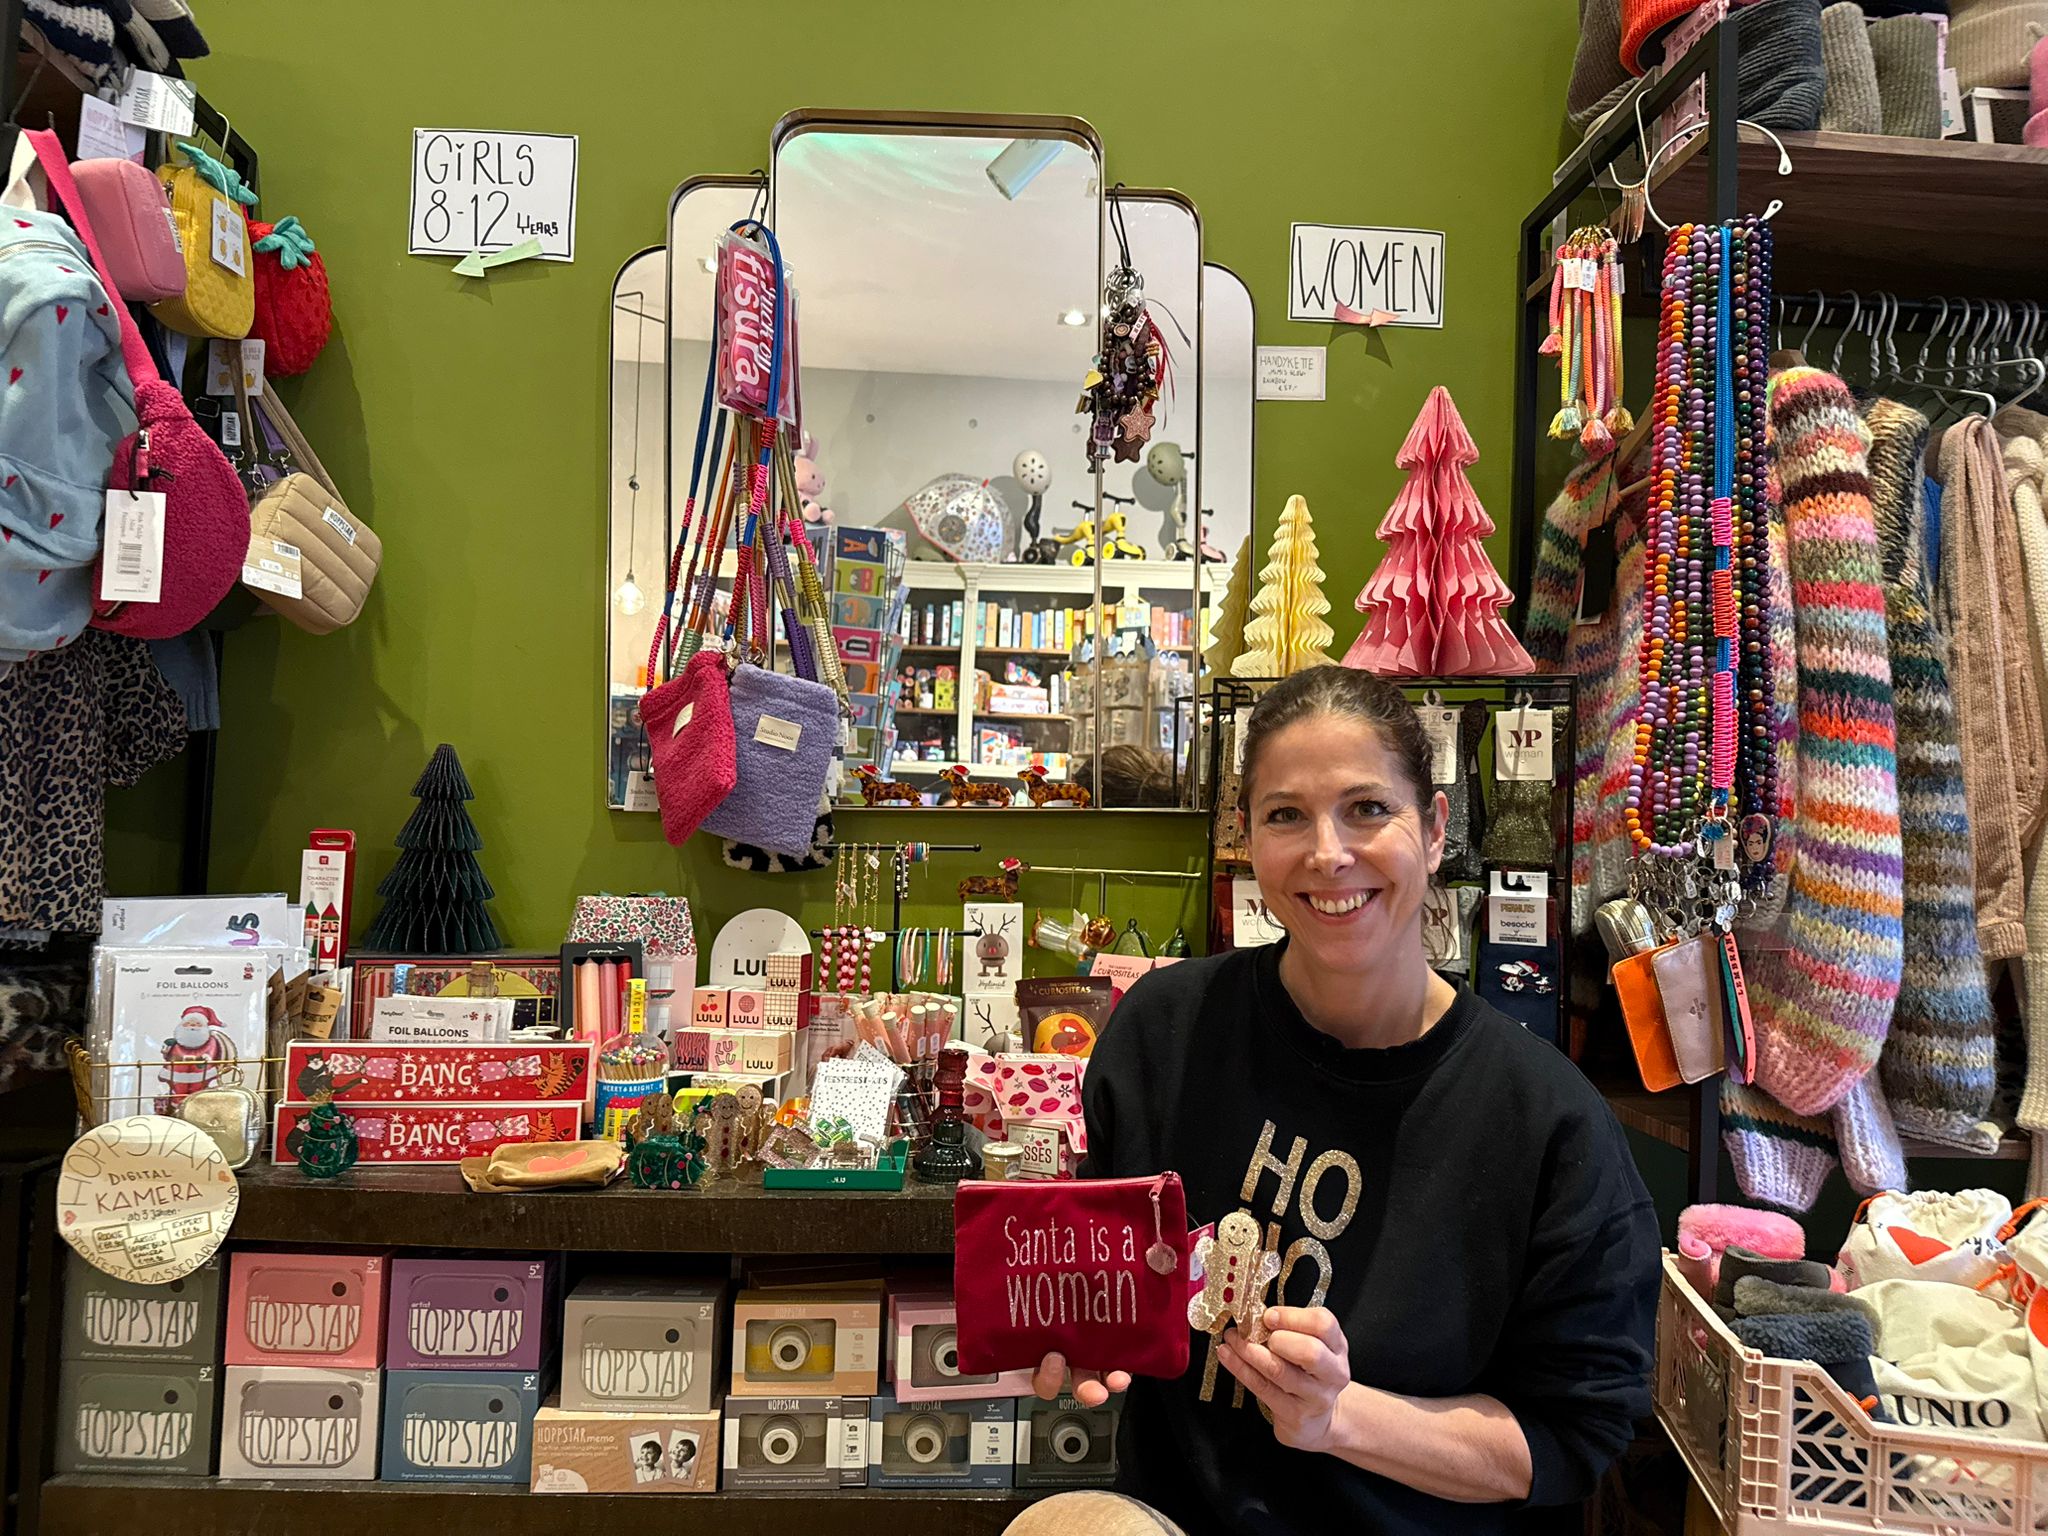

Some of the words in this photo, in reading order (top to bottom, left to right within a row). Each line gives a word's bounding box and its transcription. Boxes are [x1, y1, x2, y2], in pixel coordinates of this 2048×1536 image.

[424, 189, 513, 246] 8-12
[516, 212, 559, 237] YEARS
[1298, 235, 1437, 315] WOMEN
[329, 511, 354, 538] HOPPSTAR
[1508, 729, 1542, 749] MP
[156, 981, 178, 989] FOIL
[180, 981, 229, 989] BALLOONS
[770, 978, 796, 988] LULU
[1097, 967, 1140, 979] CURIOSITEAS
[1039, 985, 1092, 996] CURIOSITEAS
[633, 984, 642, 1025] MATCHES
[696, 1013, 722, 1023] LULU
[733, 1014, 759, 1025] LULU
[766, 1016, 793, 1026] LULU
[388, 1026, 411, 1035] FOIL
[413, 1027, 469, 1038] BALLOONS
[677, 1056, 705, 1066] LULU
[746, 1059, 774, 1070] LULU
[401, 1062, 472, 1087] BANG
[628, 1084, 654, 1092] BRIGHT
[388, 1122, 461, 1147] BANG
[60, 1116, 223, 1206] HOPPSTAR
[108, 1169, 172, 1186] DIGITAL
[1239, 1118, 1363, 1241] HO
[95, 1182, 203, 1214] KAMERA
[171, 1217, 204, 1229] EXPERT
[1004, 1214, 1076, 1268] Santa
[1089, 1218, 1111, 1263] is
[1121, 1224, 1136, 1263] a
[1006, 1268, 1137, 1329] woman
[85, 1297, 196, 1347] HOPPSTAR
[249, 1302, 358, 1350] HOPPSTAR
[410, 1309, 519, 1355] HOPPSTAR
[523, 1374, 536, 1387] 5+
[583, 1349, 691, 1398] HOPPSTAR
[768, 1400, 800, 1411] HOPPSTAR
[78, 1410, 190, 1459] HOPPSTAR
[243, 1417, 355, 1465] HOPPSTAR
[405, 1420, 515, 1467] HOPPSTAR
[537, 1426, 586, 1444] HOPPSTAR
[587, 1435, 615, 1443] memo
